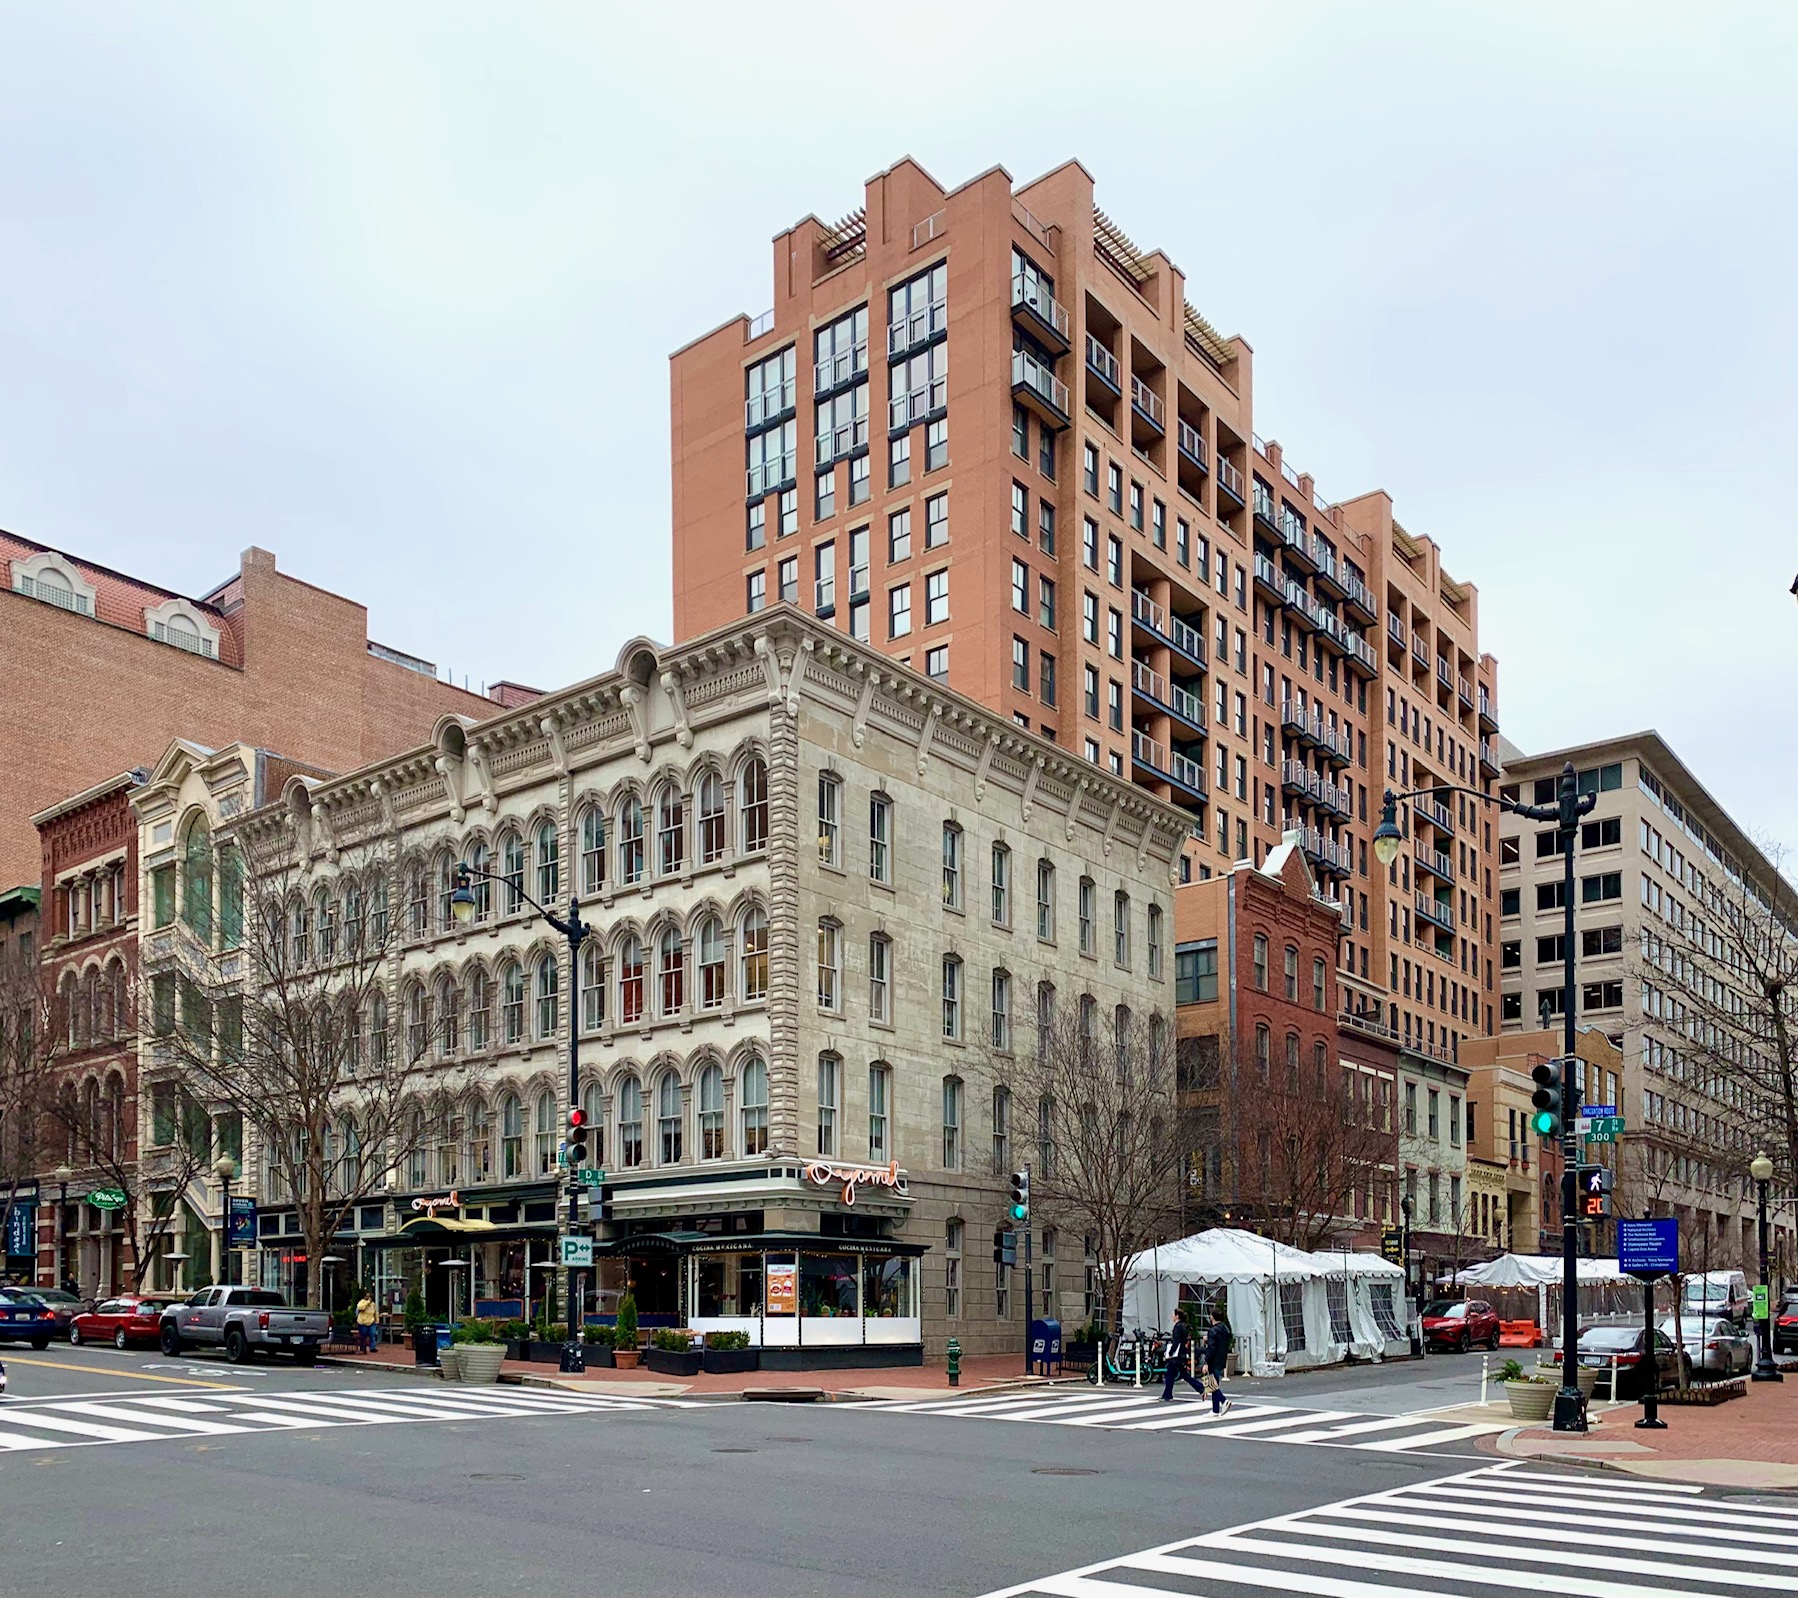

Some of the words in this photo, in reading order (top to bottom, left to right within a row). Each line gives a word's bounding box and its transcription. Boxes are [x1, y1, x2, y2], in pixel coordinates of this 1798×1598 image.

[1596, 1120, 1604, 1131] 7
[1591, 1133, 1610, 1142] 300
[585, 1170, 593, 1179] D
[807, 1160, 909, 1206] Oyamel
[411, 1190, 460, 1219] Oyamel
[565, 1241, 578, 1261] P
